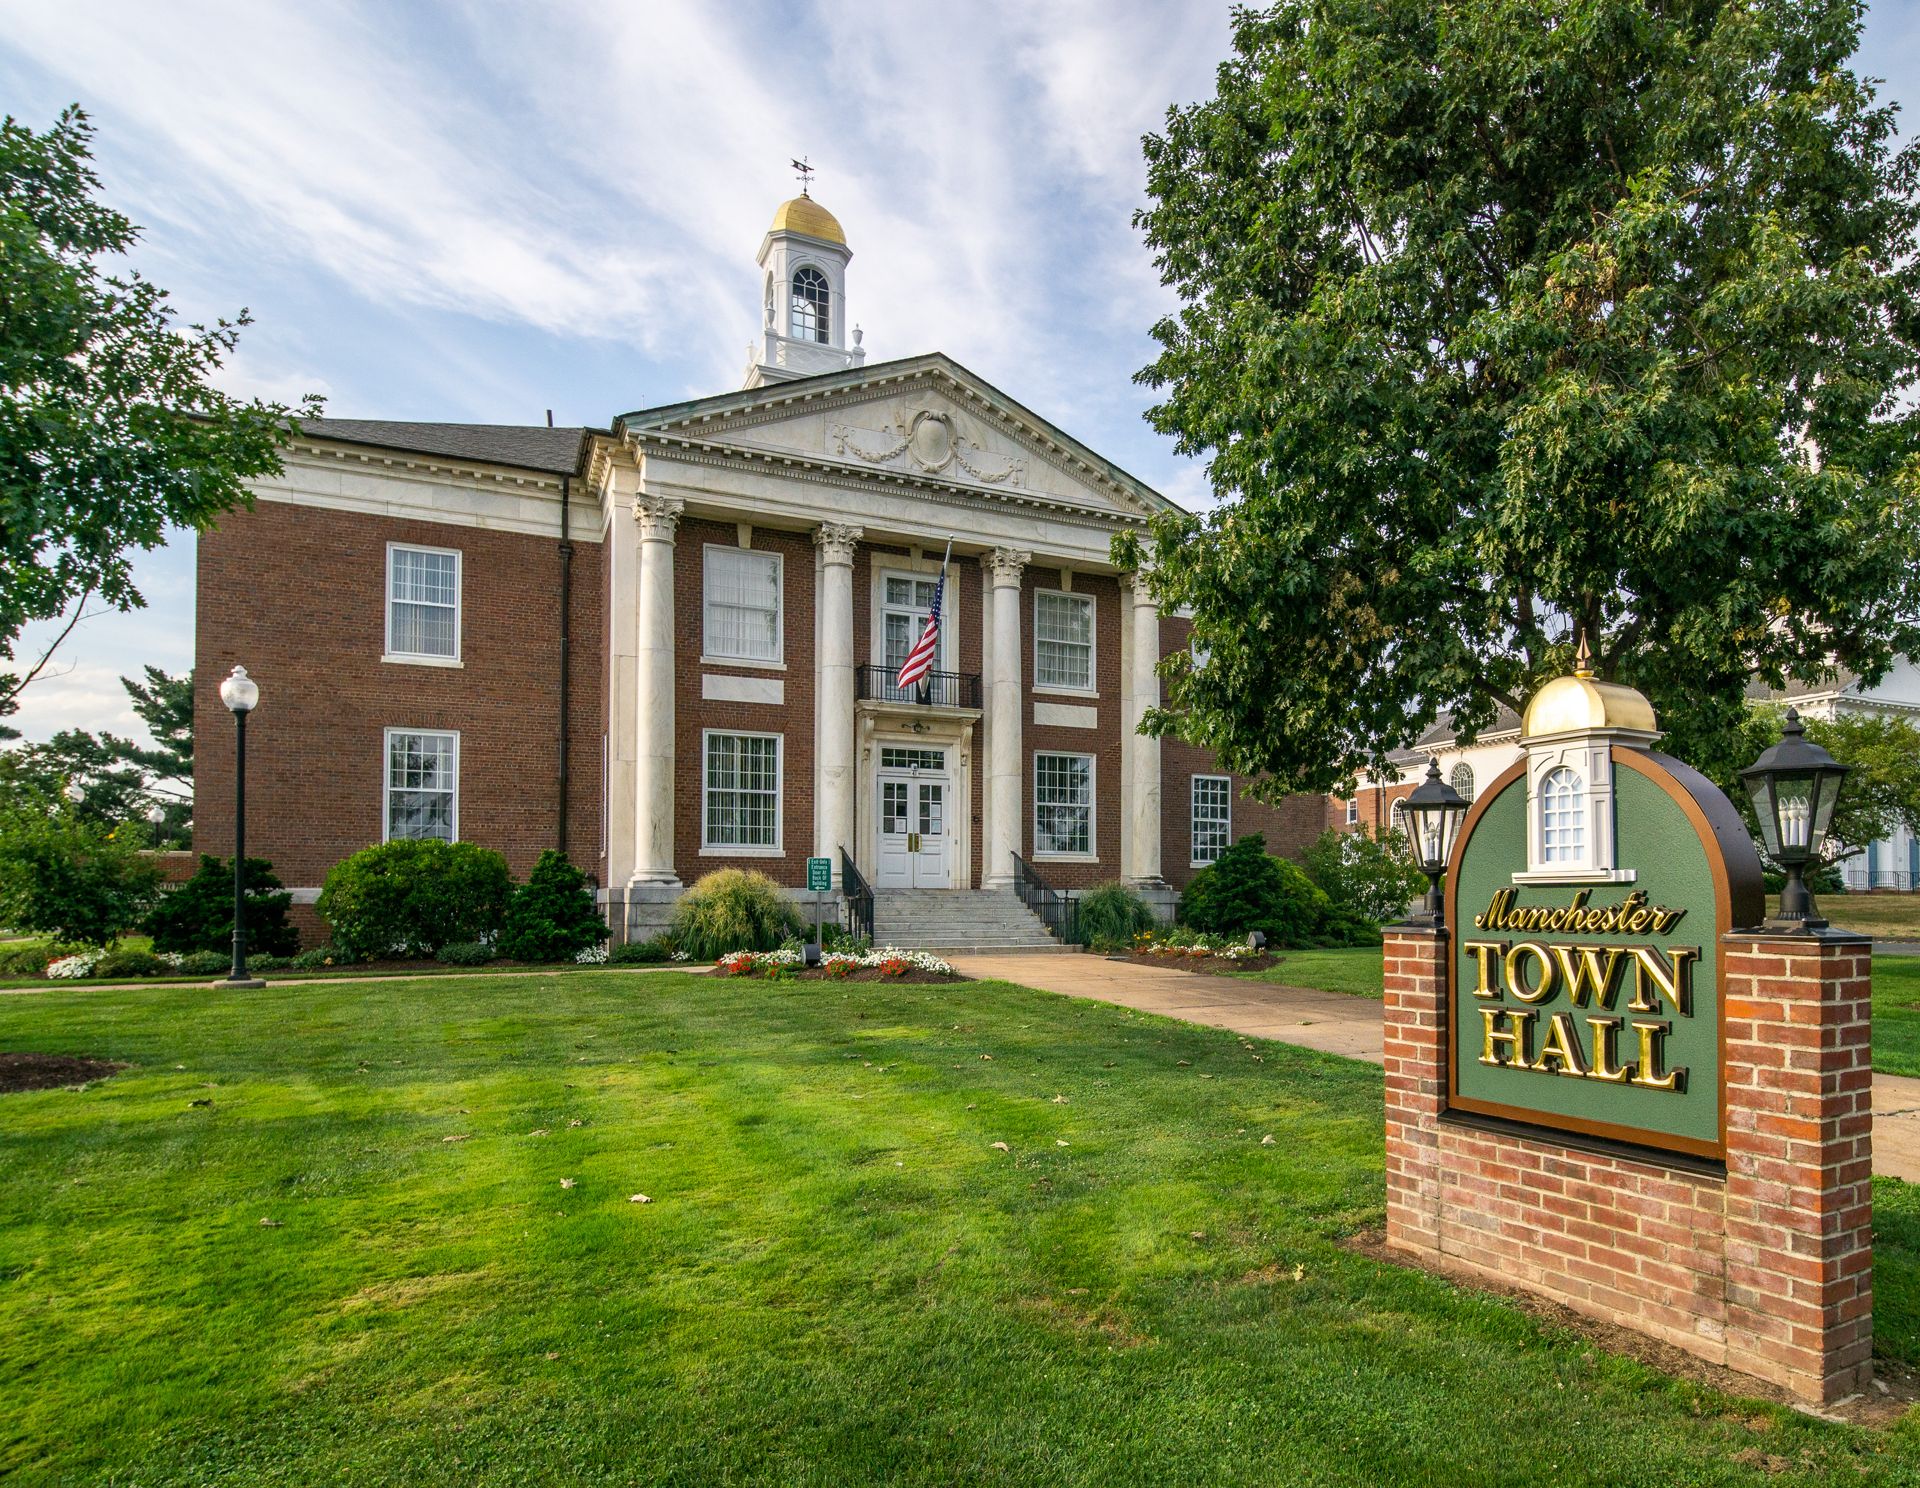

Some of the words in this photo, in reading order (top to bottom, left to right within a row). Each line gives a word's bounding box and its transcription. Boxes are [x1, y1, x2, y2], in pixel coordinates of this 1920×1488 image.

[1475, 888, 1686, 935] Manchester
[1464, 940, 1700, 1017] TOWN
[1478, 1005, 1688, 1094] HALL
